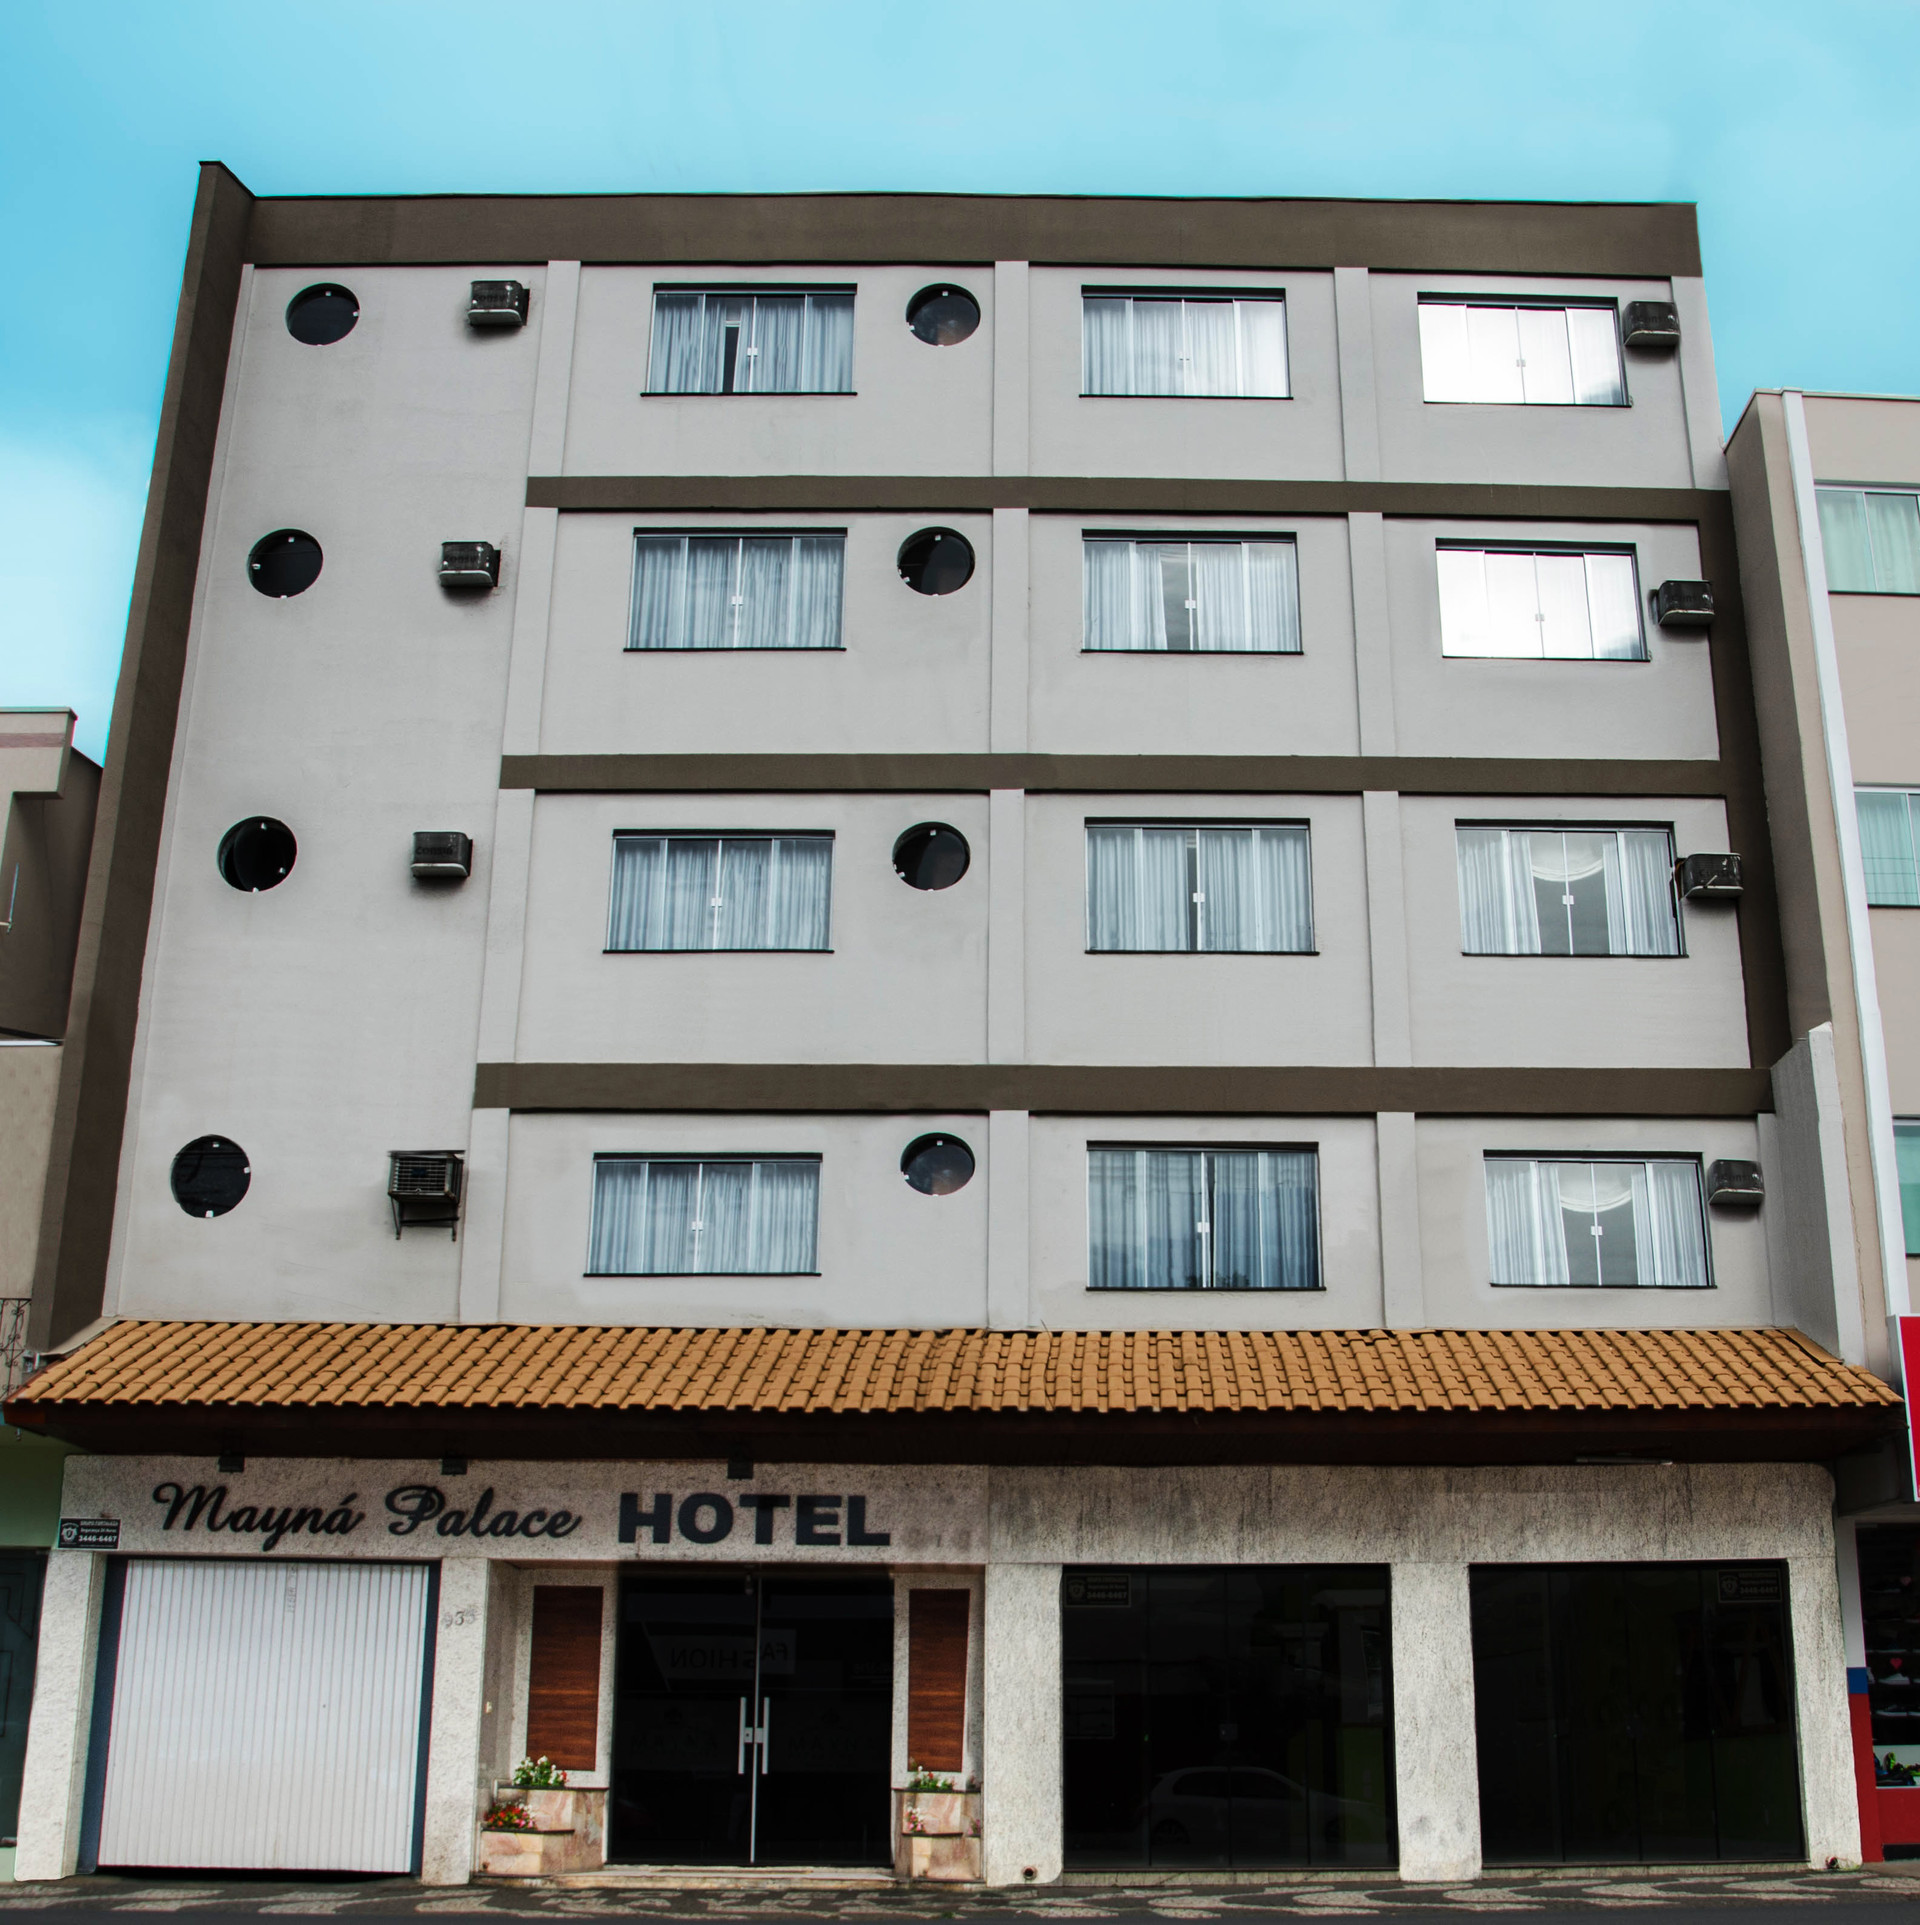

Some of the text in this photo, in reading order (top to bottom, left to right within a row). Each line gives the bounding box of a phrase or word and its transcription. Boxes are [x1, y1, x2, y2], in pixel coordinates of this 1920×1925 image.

[152, 1482, 891, 1552] Mayná Palace HOTEL
